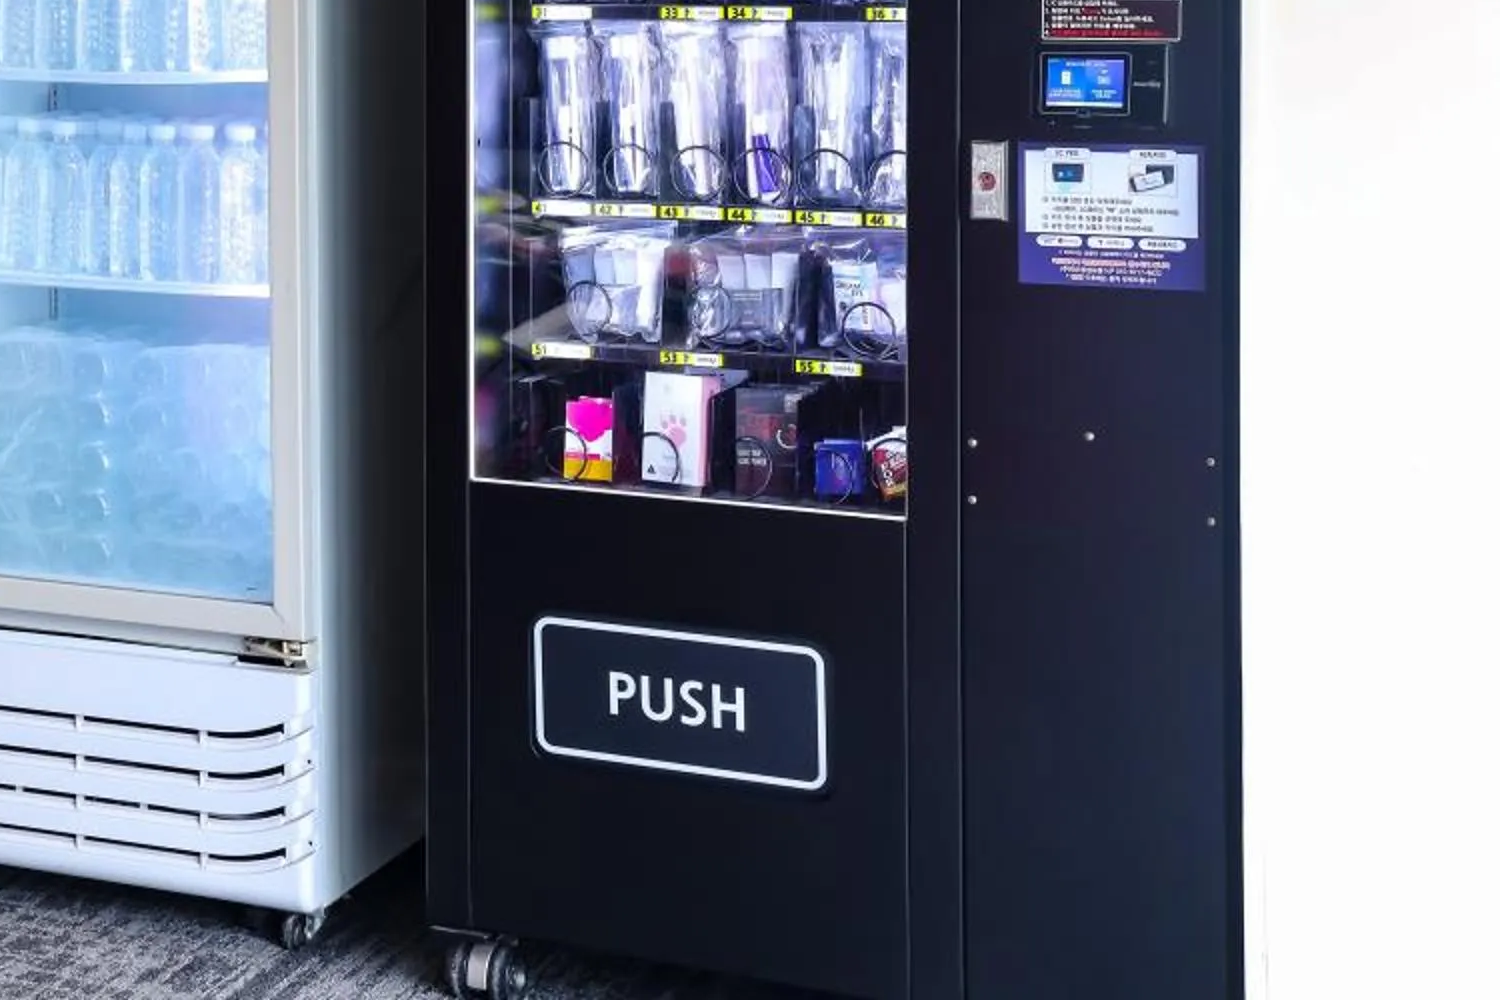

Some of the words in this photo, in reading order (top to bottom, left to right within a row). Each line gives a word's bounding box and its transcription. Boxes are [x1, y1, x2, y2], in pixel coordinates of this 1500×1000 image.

[664, 7, 677, 19] 33
[732, 7, 746, 19] 34
[731, 209, 746, 221] 44
[800, 211, 815, 223] 45
[608, 669, 746, 732] PUSH
